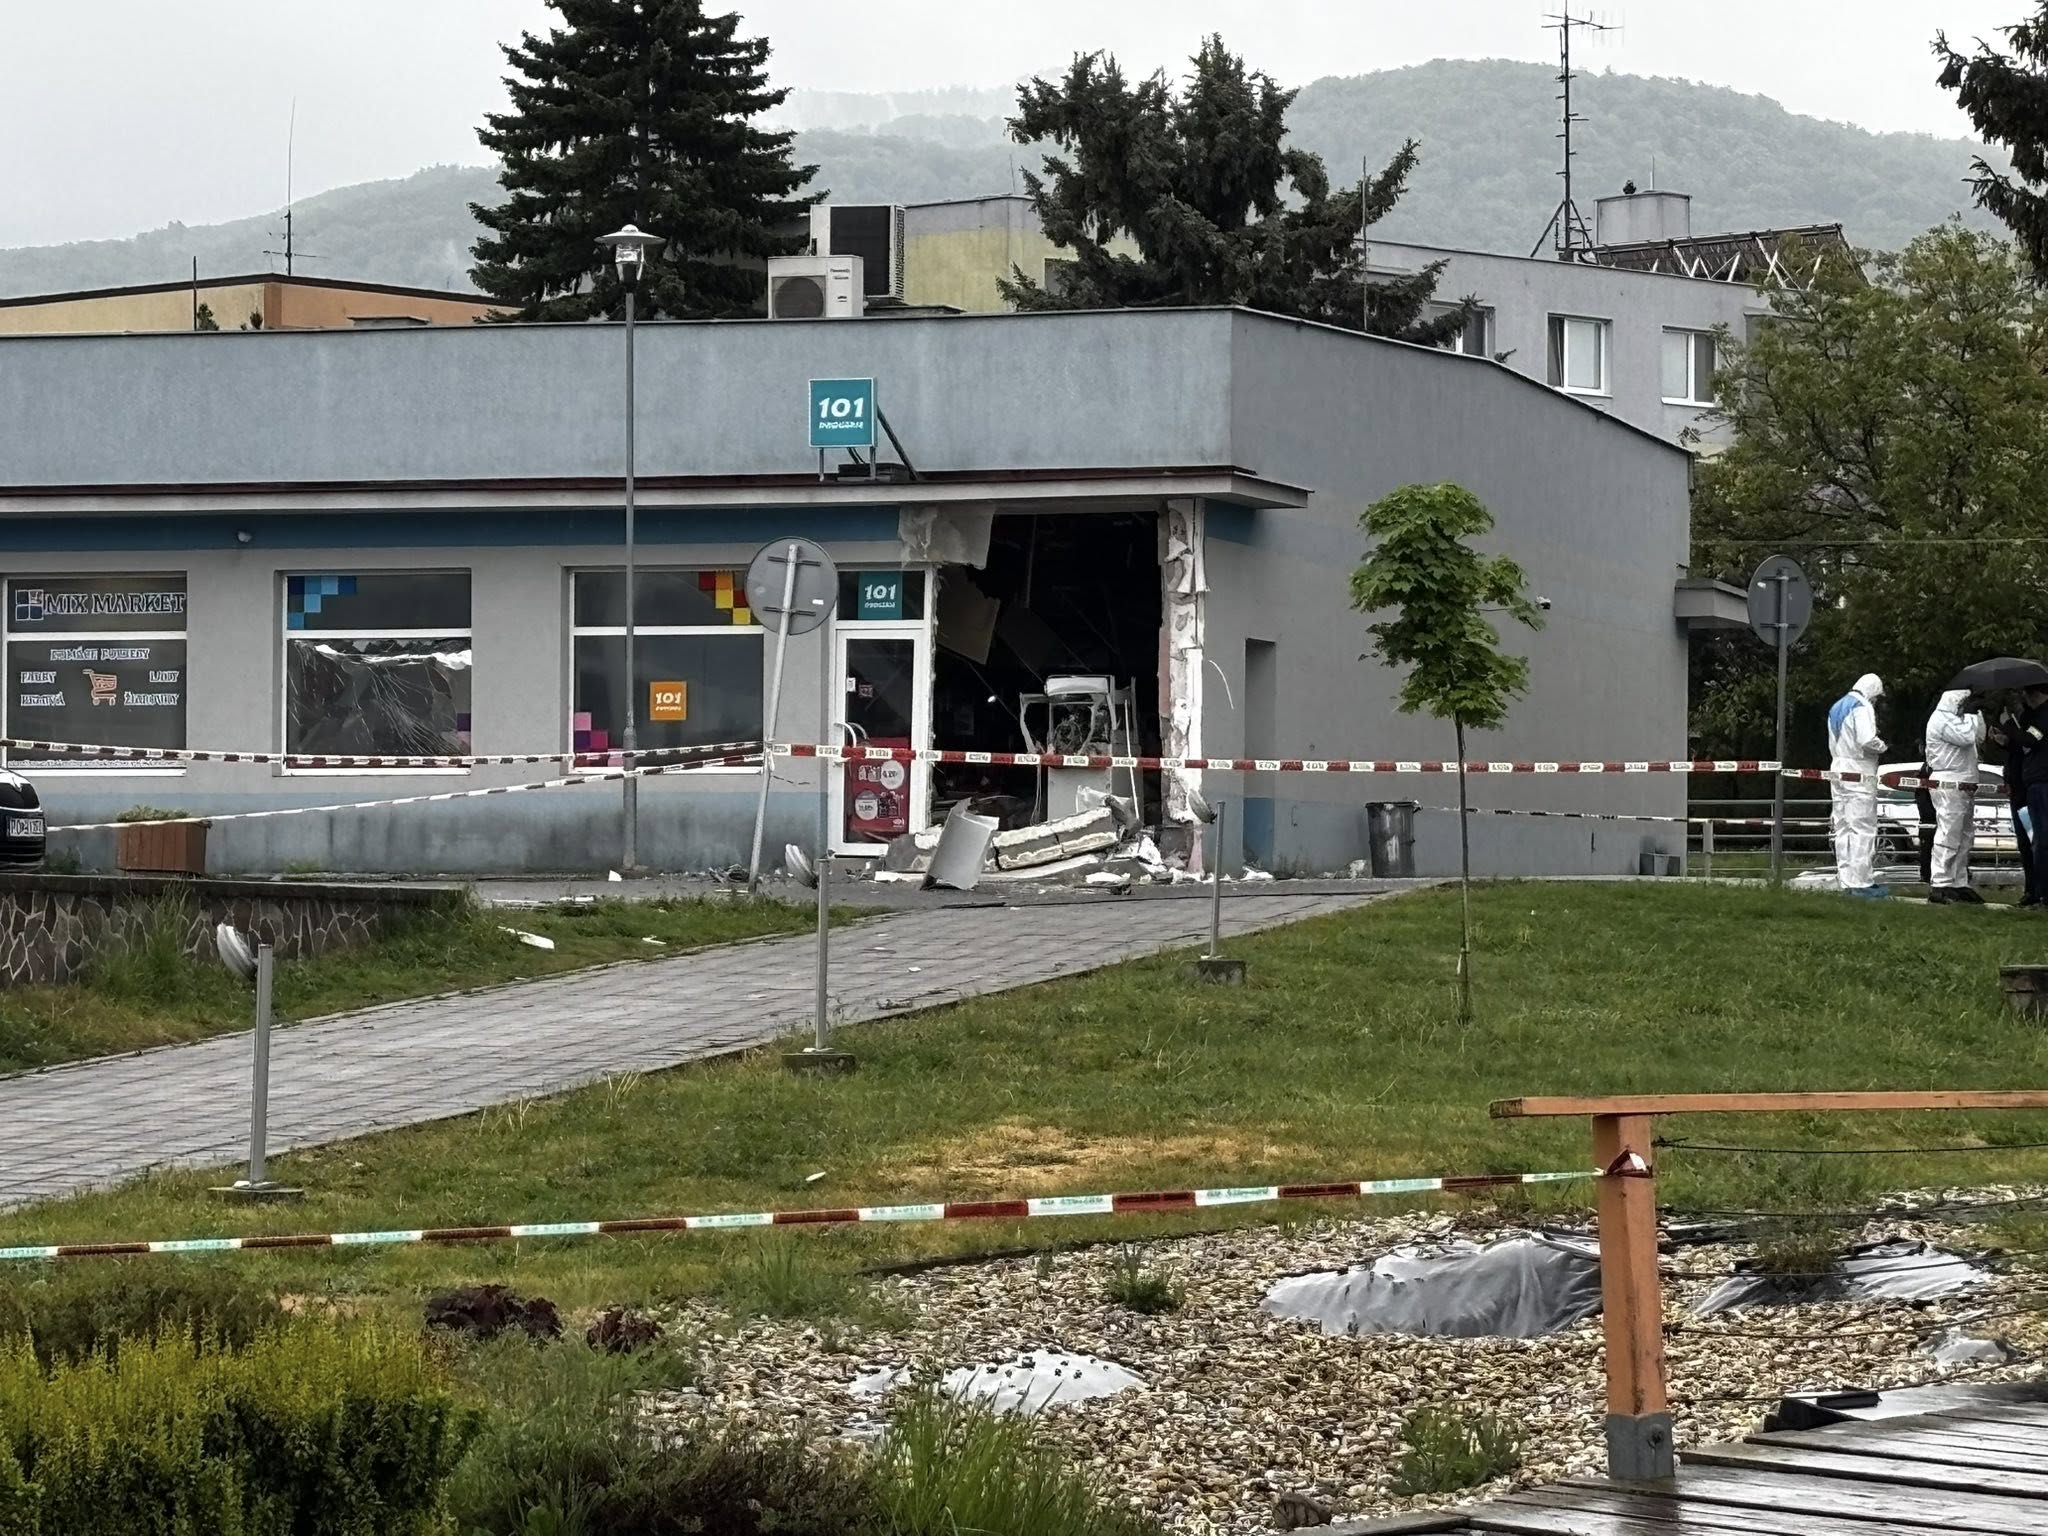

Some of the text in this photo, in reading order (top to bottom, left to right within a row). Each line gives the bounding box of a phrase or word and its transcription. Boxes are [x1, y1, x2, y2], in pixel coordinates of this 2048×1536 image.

[819, 397, 864, 418] 101
[865, 584, 896, 600] 101
[45, 592, 186, 614] MIX MARKET
[656, 692, 682, 704] 101
